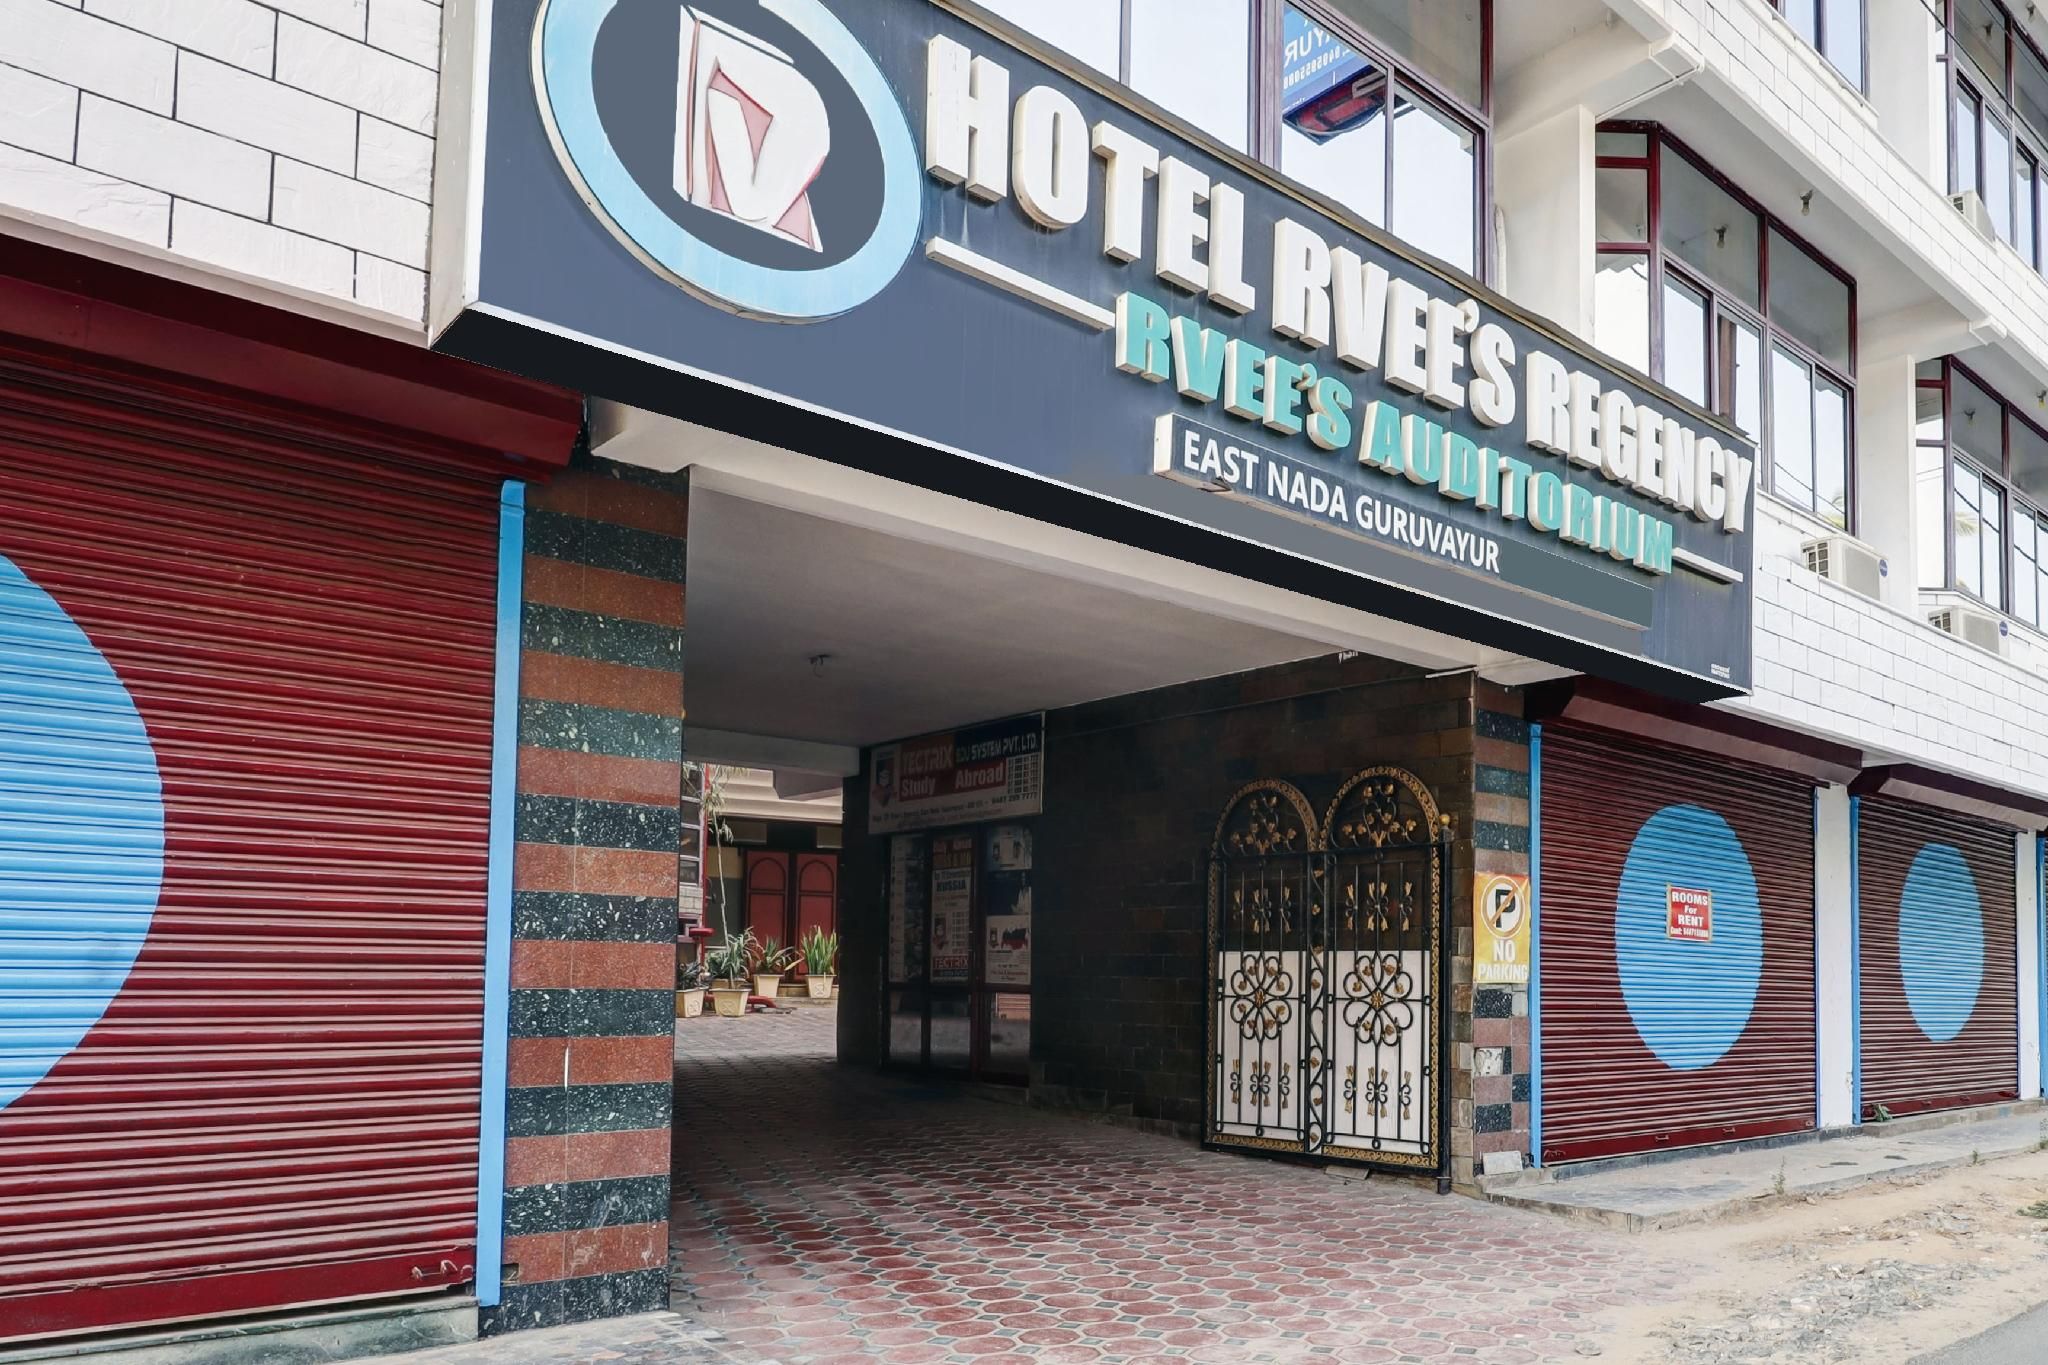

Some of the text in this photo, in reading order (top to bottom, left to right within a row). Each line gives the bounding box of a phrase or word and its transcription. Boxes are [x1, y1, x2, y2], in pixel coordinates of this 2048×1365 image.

[927, 34, 1753, 534] HOTEL RVEE'S REGENCY
[1115, 291, 1674, 576] RVEE'S AUDITORIUM
[1183, 430, 1501, 573] EAST NADA GURUVAYUR
[971, 739, 1002, 760] SYSTEM
[902, 776, 936, 798] Study
[955, 762, 1004, 789] Abroad
[1672, 891, 1708, 906] ROOMS
[1684, 905, 1698, 914] For
[1678, 914, 1704, 927] RENT
[1493, 940, 1515, 962] NO
[1479, 963, 1528, 981] PARKING
